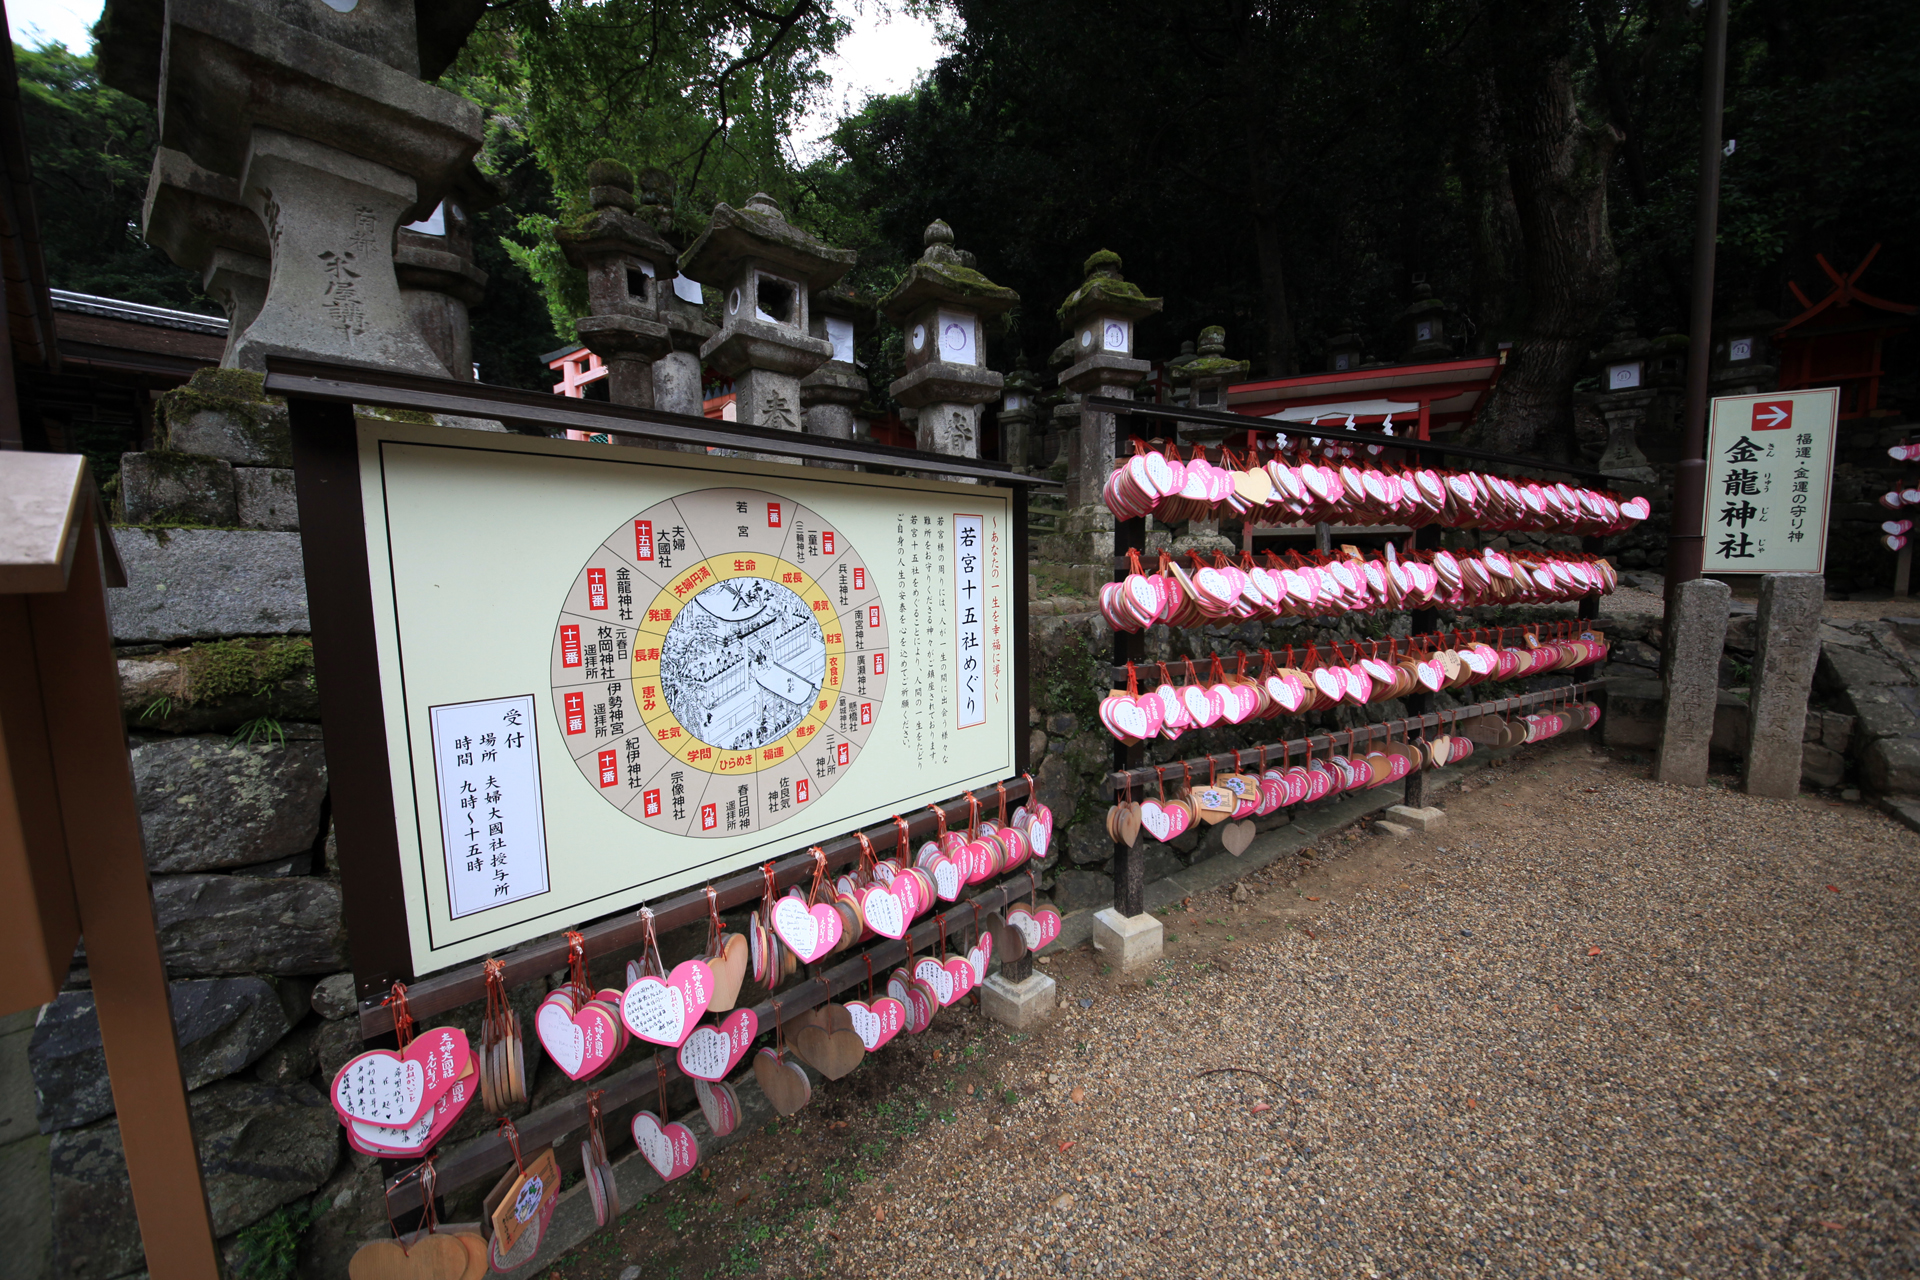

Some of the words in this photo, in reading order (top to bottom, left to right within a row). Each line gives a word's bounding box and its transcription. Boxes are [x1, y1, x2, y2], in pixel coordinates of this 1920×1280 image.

[348, 206, 378, 260] 南都
[1766, 443, 1775, 458] きん
[1715, 436, 1765, 559] 金龍神社
[1787, 433, 1813, 543] 福運・金運の守り神
[736, 501, 749, 538] 若宮
[770, 506, 780, 524] 一番
[1759, 507, 1770, 522] じん
[637, 524, 652, 558] 十五番
[657, 529, 672, 568] 大國社
[672, 526, 685, 551] 夫婦
[808, 530, 818, 556] 一童社
[824, 534, 833, 553] 二番
[733, 559, 756, 572] 生命
[782, 572, 803, 583] 成長
[855, 570, 863, 588] 三番
[590, 572, 605, 607] 十四番
[616, 567, 633, 620] 金龍神社
[674, 566, 711, 598] 夫婦円満
[839, 564, 848, 606] 兵主神社
[649, 609, 672, 622] 発達
[813, 600, 829, 611] 勇気
[871, 608, 879, 626] 四番
[854, 610, 864, 649] 南宮神社
[897, 513, 911, 749] ご自身の人生の安泰を心を込めてご祈願ください。
[960, 527, 979, 716] 若宮十五社めぐり
[563, 629, 579, 664] 十三番
[598, 626, 615, 679] 枚岡神社
[616, 629, 627, 660] 元春日
[826, 633, 842, 644] 財宝
[910, 515, 924, 771] 若宮十五社をめぐることにより、人間の一生をたどり
[923, 516, 938, 765] 難所をお守りくださる神々がご鎮座されております。
[937, 516, 949, 764] 若宮様の周りには、人が一生の間に出会う様々な
[635, 648, 660, 662] 長寿
[875, 655, 883, 673] 五番
[829, 657, 838, 686] 衣食住
[567, 697, 582, 731] 十二番
[607, 683, 624, 736] 伊勢神宮
[642, 686, 656, 711] 恵み
[819, 700, 828, 711] 夢
[861, 705, 870, 723] 六番
[503, 709, 524, 749] 受付
[657, 727, 681, 741] 生気
[796, 725, 815, 738] 進歩
[455, 736, 473, 767] 時間
[479, 732, 498, 763] 場所
[626, 737, 642, 789] 紀伊神社
[687, 747, 712, 763] 学問
[720, 754, 753, 771] ひらめき
[763, 746, 784, 761] 福運
[826, 734, 836, 776] 三十八所
[839, 746, 847, 764] 七番
[601, 755, 615, 783] 十一番
[816, 757, 826, 778] 神社
[646, 792, 659, 815] 十番
[671, 771, 685, 820] 宗像神社
[738, 784, 750, 830] 春日明神
[768, 790, 779, 813] 神社
[780, 777, 791, 810] 佐良気
[798, 782, 807, 801] 八番
[704, 807, 715, 828] 九番
[484, 775, 510, 897] 夫婦大國社授与所
[684, 980, 696, 1013] えんむすび
[692, 964, 706, 1005] 夫婦大國社
[426, 1051, 439, 1089] えんむすび
[440, 1033, 455, 1079] 夫婦大國社
[406, 1064, 416, 1102] おねがいごと
